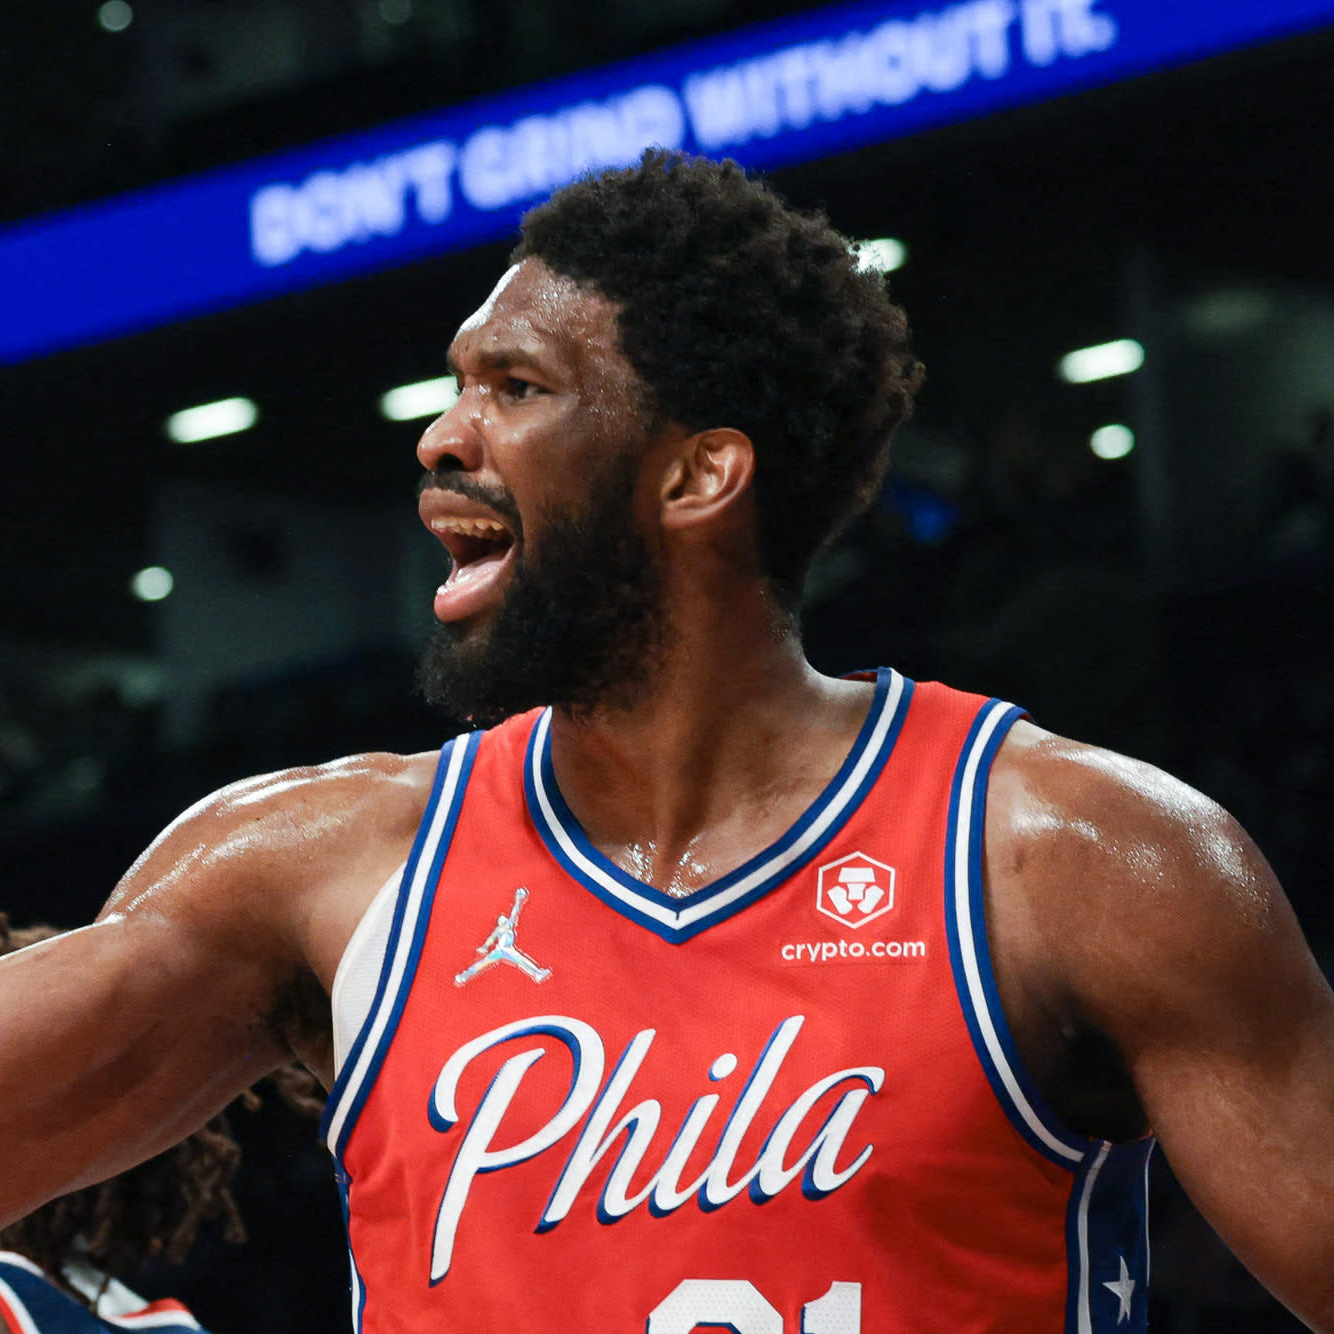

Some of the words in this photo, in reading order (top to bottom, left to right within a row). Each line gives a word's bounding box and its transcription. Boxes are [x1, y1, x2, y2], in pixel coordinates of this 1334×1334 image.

[248, 137, 462, 267] DON'T
[458, 84, 685, 211] GRIND
[681, 1, 1017, 149] WITHOUT
[781, 939, 927, 963] crypto.com
[428, 1014, 885, 1287] Phila
